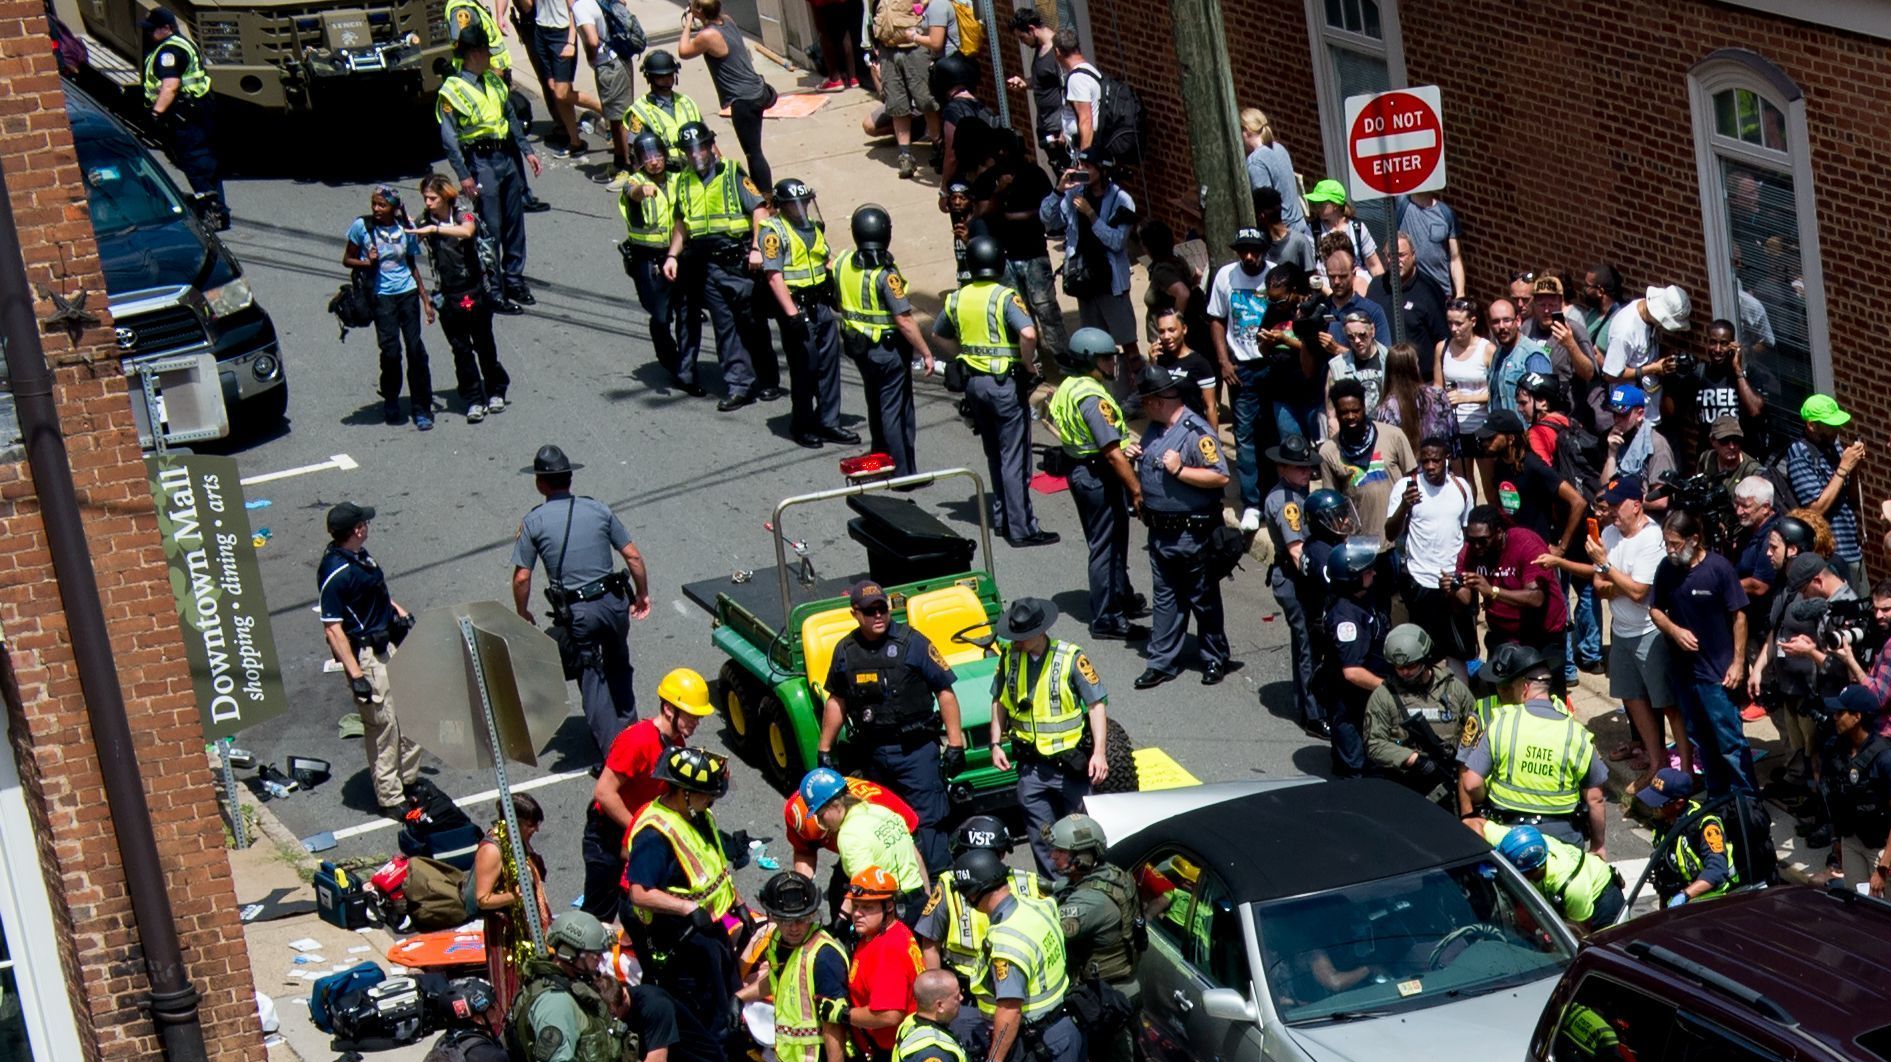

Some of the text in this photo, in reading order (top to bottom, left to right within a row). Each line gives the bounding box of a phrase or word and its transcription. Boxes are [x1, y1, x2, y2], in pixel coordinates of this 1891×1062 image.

[1364, 111, 1423, 133] DO NOT
[1373, 155, 1422, 176] ENTER
[160, 465, 242, 726] Downtown Mall
[204, 474, 265, 702] shopping dining arts
[1525, 745, 1554, 761] STATE
[1520, 760, 1555, 777] POLICE
[967, 830, 996, 847] VSP
